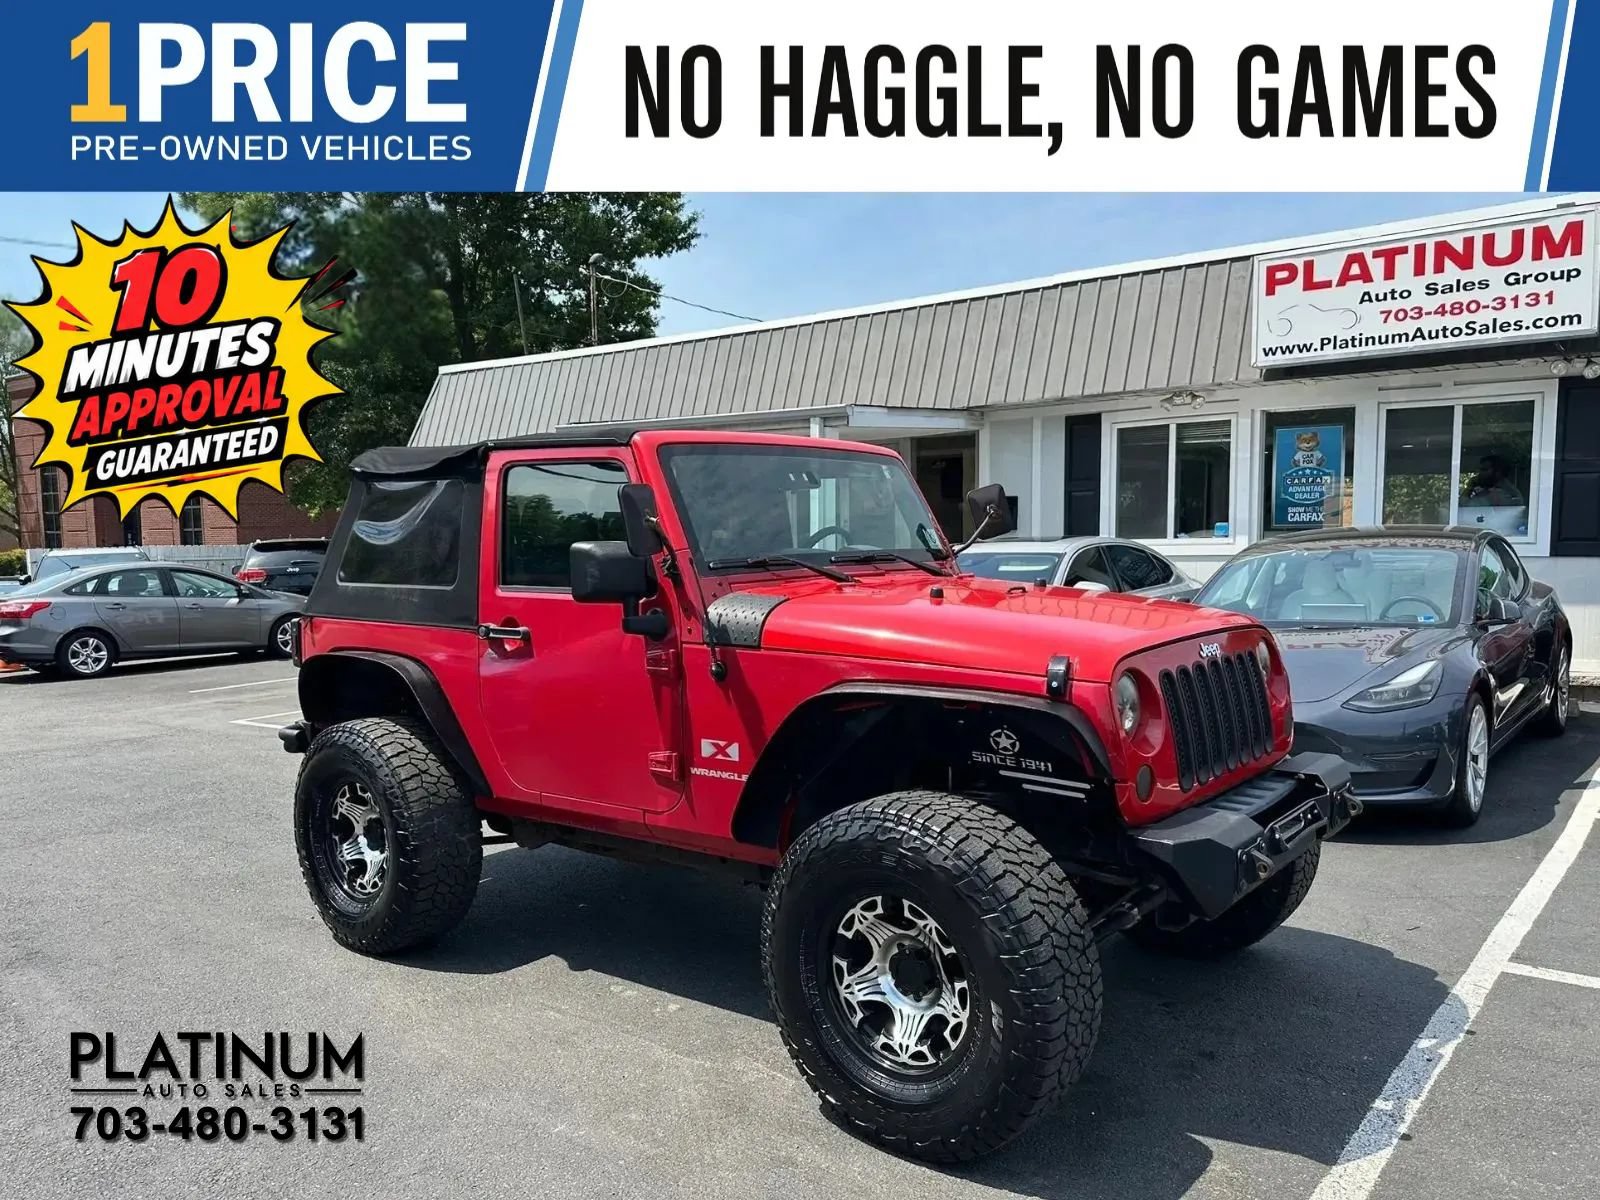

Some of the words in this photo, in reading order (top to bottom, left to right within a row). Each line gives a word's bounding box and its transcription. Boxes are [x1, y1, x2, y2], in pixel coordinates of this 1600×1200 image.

[1265, 219, 1585, 297] PLATINUM
[1359, 287, 1413, 305] Auto
[1424, 277, 1491, 297] Sales
[1503, 266, 1582, 288] Group
[1379, 290, 1556, 325] 703-480-3131
[1262, 312, 1583, 358] www.PlatinumAutoSales.com
[1286, 477, 1330, 485] CARFAX
[1287, 512, 1325, 522] CARFAX
[1199, 642, 1221, 658] Jeep
[971, 751, 1017, 767] SINCE
[1019, 758, 1053, 773] 1941
[689, 766, 749, 782] WRANGLE
